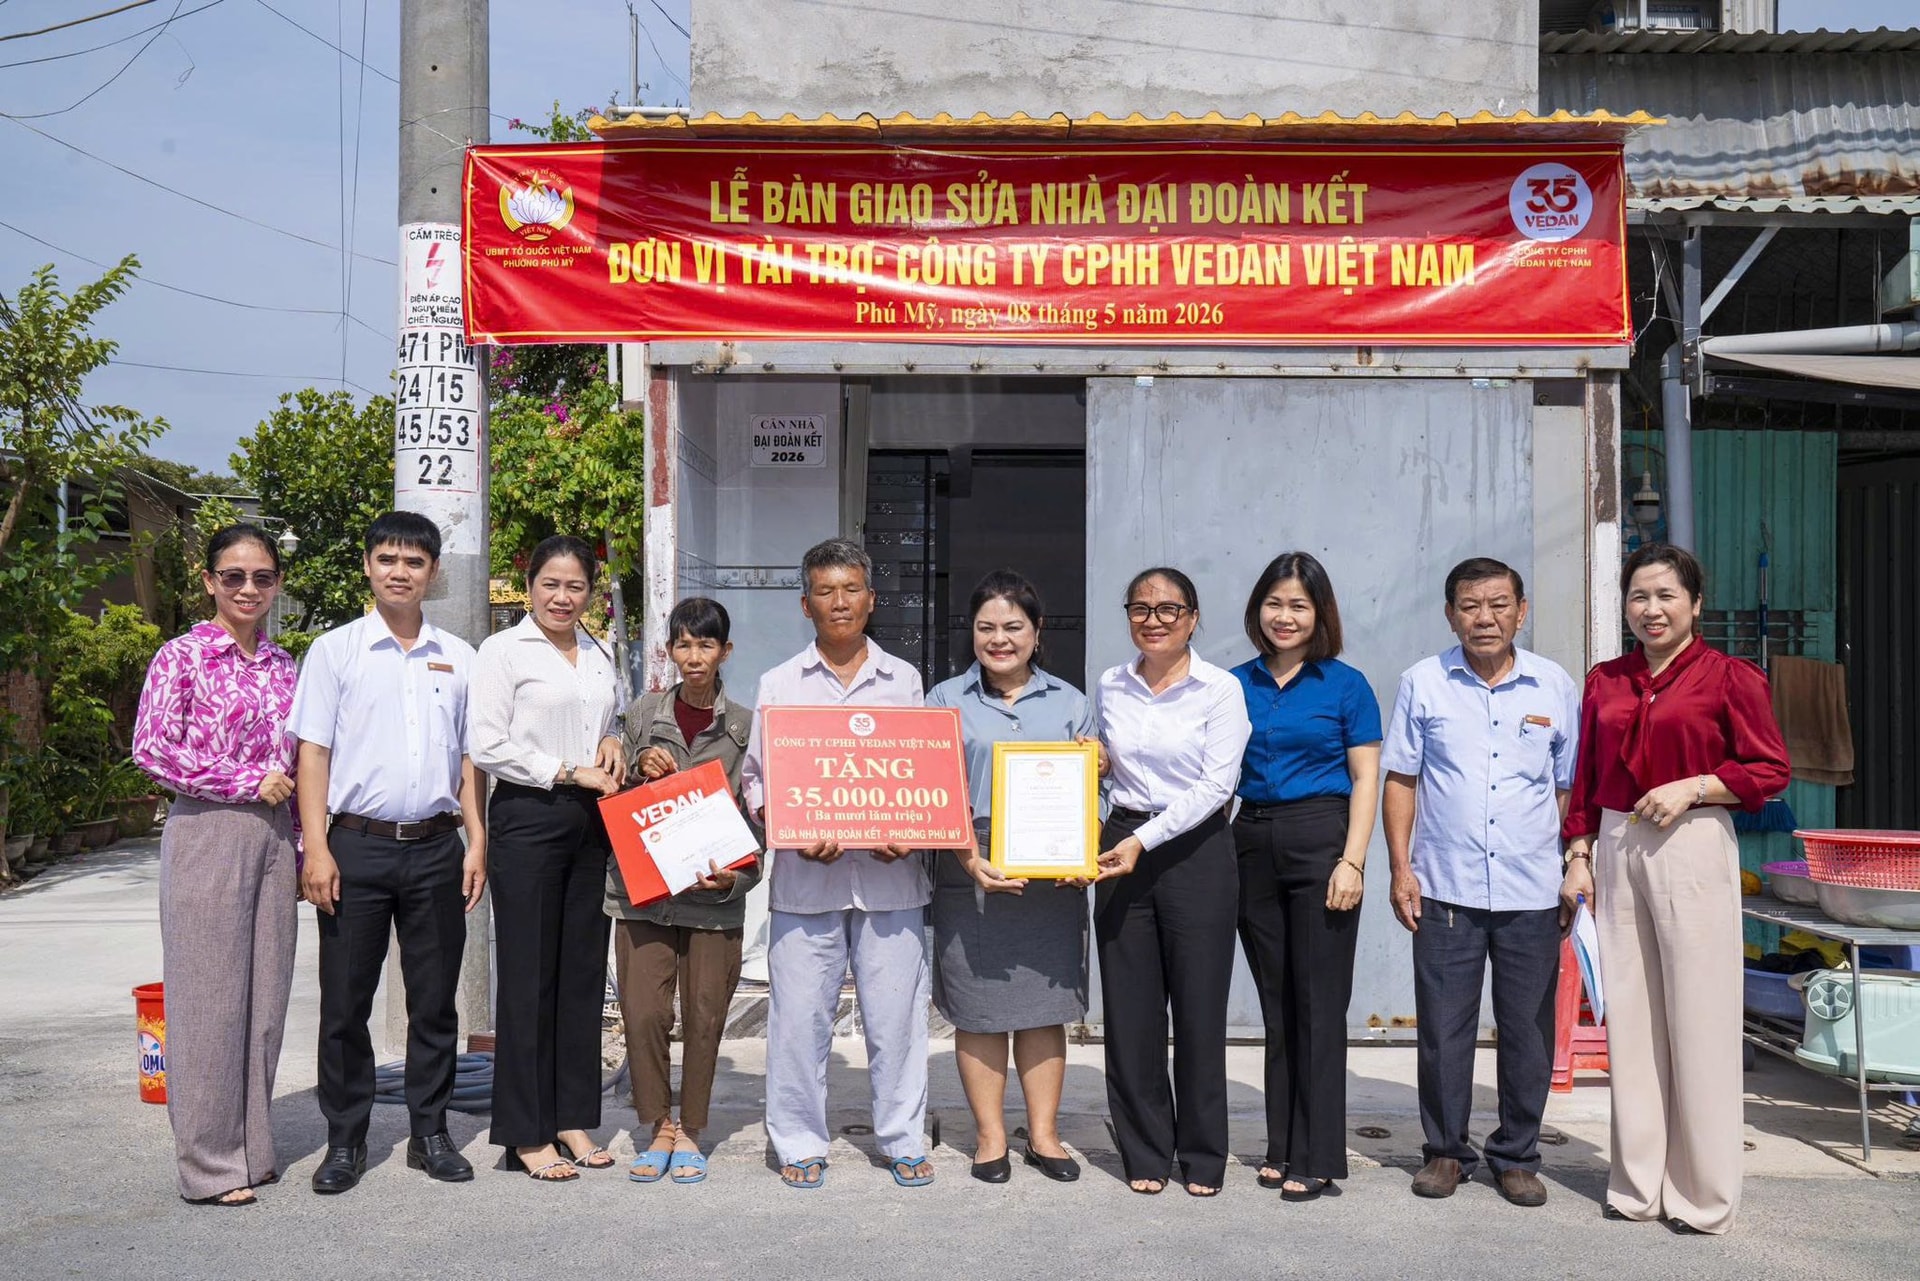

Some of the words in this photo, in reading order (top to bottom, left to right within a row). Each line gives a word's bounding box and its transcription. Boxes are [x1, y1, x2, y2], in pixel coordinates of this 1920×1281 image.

[710, 167, 750, 224] LỄ
[762, 174, 836, 224] BÀN
[851, 183, 932, 224] GIAO
[947, 170, 1018, 225] SỬA
[1030, 174, 1105, 224] NHÀ
[1117, 183, 1177, 233] ĐẠI
[1189, 174, 1290, 224] ĐOÀN
[1303, 170, 1368, 224] KẾT
[1526, 178, 1578, 214] 35
[1524, 214, 1579, 228] VEDAN
[409, 227, 432, 241] CẤM
[434, 229, 461, 242] TRÈO
[485, 247, 510, 256] UBMT
[525, 244, 550, 256] QUỐC
[552, 245, 571, 255] VIỆT
[572, 246, 592, 254] NAM
[1548, 247, 1558, 255] TY
[1561, 247, 1587, 255] CPHH
[541, 257, 560, 267] PHÚ
[607, 237, 681, 284] ĐƠN
[692, 241, 726, 293] VỊ
[738, 235, 792, 284] TÀI
[897, 236, 996, 286] CÔNG
[1008, 244, 1050, 285] TY
[1062, 244, 1159, 285] CPHH
[1171, 244, 1290, 285] VEDAN
[1302, 236, 1379, 295] VIỆT
[1391, 244, 1475, 287] NAM
[1514, 259, 1545, 267] VEDAN
[1548, 257, 1568, 268] VIỆT
[1571, 259, 1592, 267] NAM
[429, 293, 441, 303] ÁP
[442, 296, 461, 305] CAO
[412, 305, 435, 313] NGUY
[855, 301, 896, 324] Phú
[904, 301, 944, 330] Mỹ,
[951, 301, 1000, 329] ngày
[1007, 303, 1031, 324] 08
[1038, 302, 1098, 330] tháng
[1104, 303, 1116, 324] 5
[1123, 303, 1168, 324] năm
[1175, 302, 1224, 324] 2026
[399, 331, 429, 363] 471
[440, 331, 474, 365] PM
[398, 373, 421, 405] 24
[437, 372, 464, 403] 15
[398, 414, 422, 445] 45
[437, 414, 470, 446] 53
[760, 418, 786, 429] CĂN
[789, 417, 815, 429] NHÀ
[754, 435, 771, 450] ĐẠI
[773, 431, 801, 447] ĐOÀN
[804, 431, 822, 447] KẾT
[771, 452, 805, 462] 2026
[418, 454, 453, 485] 22
[854, 717, 870, 727] 35
[774, 737, 805, 748] CÔNG
[809, 738, 823, 748] TY
[825, 738, 856, 748] CPHH
[860, 739, 895, 748] VEDAN
[899, 738, 925, 750] VIỆT
[927, 739, 951, 749] NAM
[814, 752, 915, 784] TẶNG
[786, 786, 948, 808] 35.000.000
[632, 789, 705, 827] VEDAN
[806, 810, 810, 822] (
[815, 811, 831, 821] Ba
[835, 810, 866, 821] mươi
[869, 810, 892, 821] lăm
[895, 810, 923, 824] triệu
[927, 810, 932, 822] )
[779, 826, 797, 840] SỬA
[800, 827, 817, 840] NHÀ
[820, 829, 835, 841] ĐẠI
[837, 826, 862, 840] ĐOÀN
[864, 825, 881, 840] KẾT
[889, 826, 926, 840] PHƯỜNG
[928, 826, 946, 840] PHÚ
[949, 826, 961, 840] MỸ
